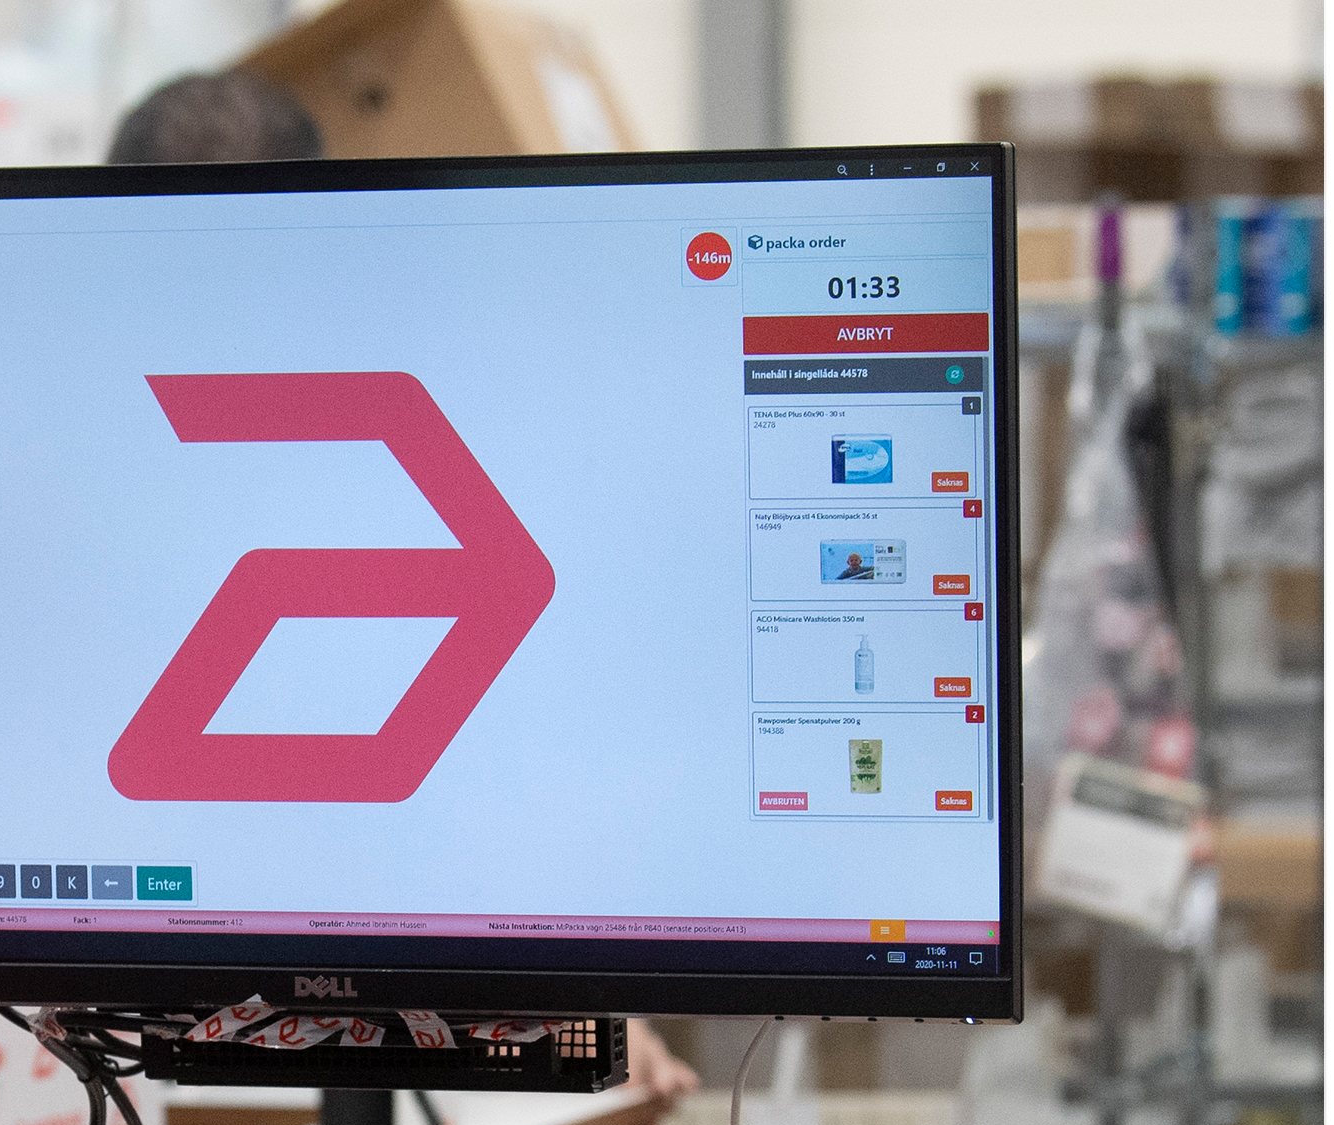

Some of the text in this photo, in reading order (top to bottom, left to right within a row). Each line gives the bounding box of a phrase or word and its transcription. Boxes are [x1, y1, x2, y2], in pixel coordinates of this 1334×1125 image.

[766, 236, 846, 252] packa order
[688, 251, 732, 265] -146m
[828, 276, 901, 299] 01:33
[837, 327, 894, 341] AVBRYT
[840, 369, 868, 378] 44578
[937, 478, 964, 487] Saknas
[938, 581, 965, 589] Saknas
[939, 683, 966, 692] Saknas
[762, 797, 805, 806] AVBRUTEN
[940, 796, 967, 805] Saknas
[68, 876, 77, 889] K
[148, 877, 183, 891] Enter
[73, 916, 91, 924] Fack:
[168, 918, 229, 926] Stationsnummer:
[926, 947, 947, 956] 11:06
[915, 960, 958, 969] 2020-11-11
[294, 975, 358, 999] DELL
